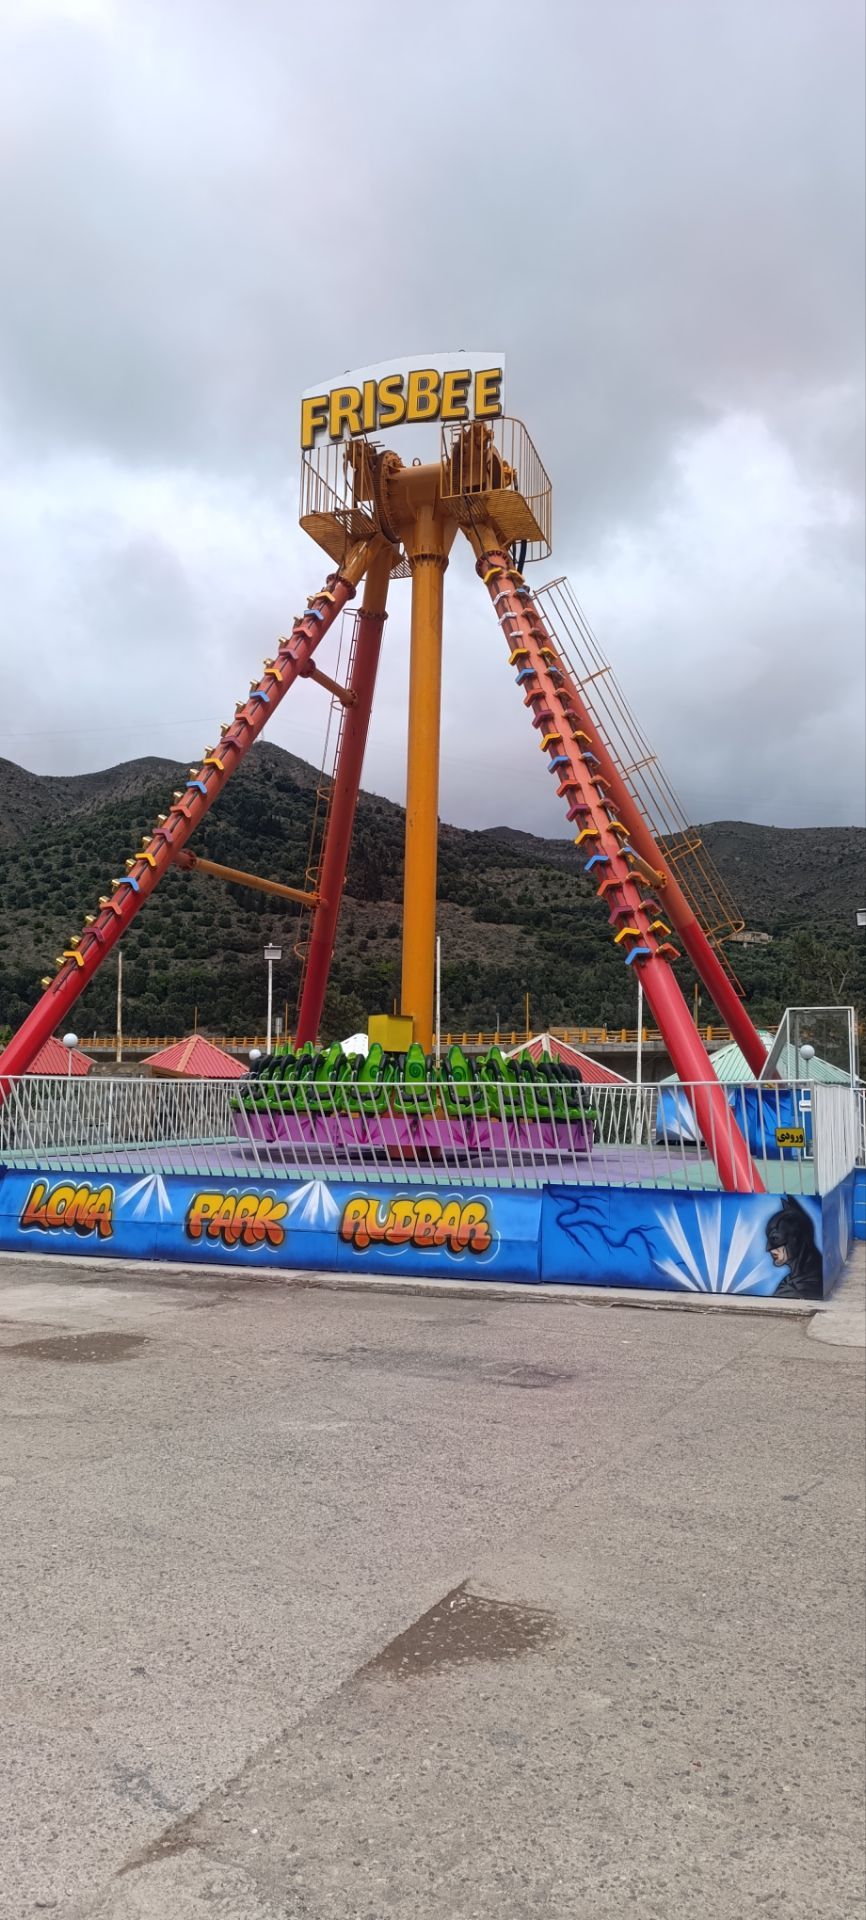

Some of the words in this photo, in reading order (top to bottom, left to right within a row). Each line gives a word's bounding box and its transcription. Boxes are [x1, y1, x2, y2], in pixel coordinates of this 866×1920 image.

[301, 367, 502, 451] FRISBEE
[19, 1183, 114, 1240] LONA
[186, 1192, 289, 1246] PARK
[340, 1198, 492, 1253] RUDBAR
